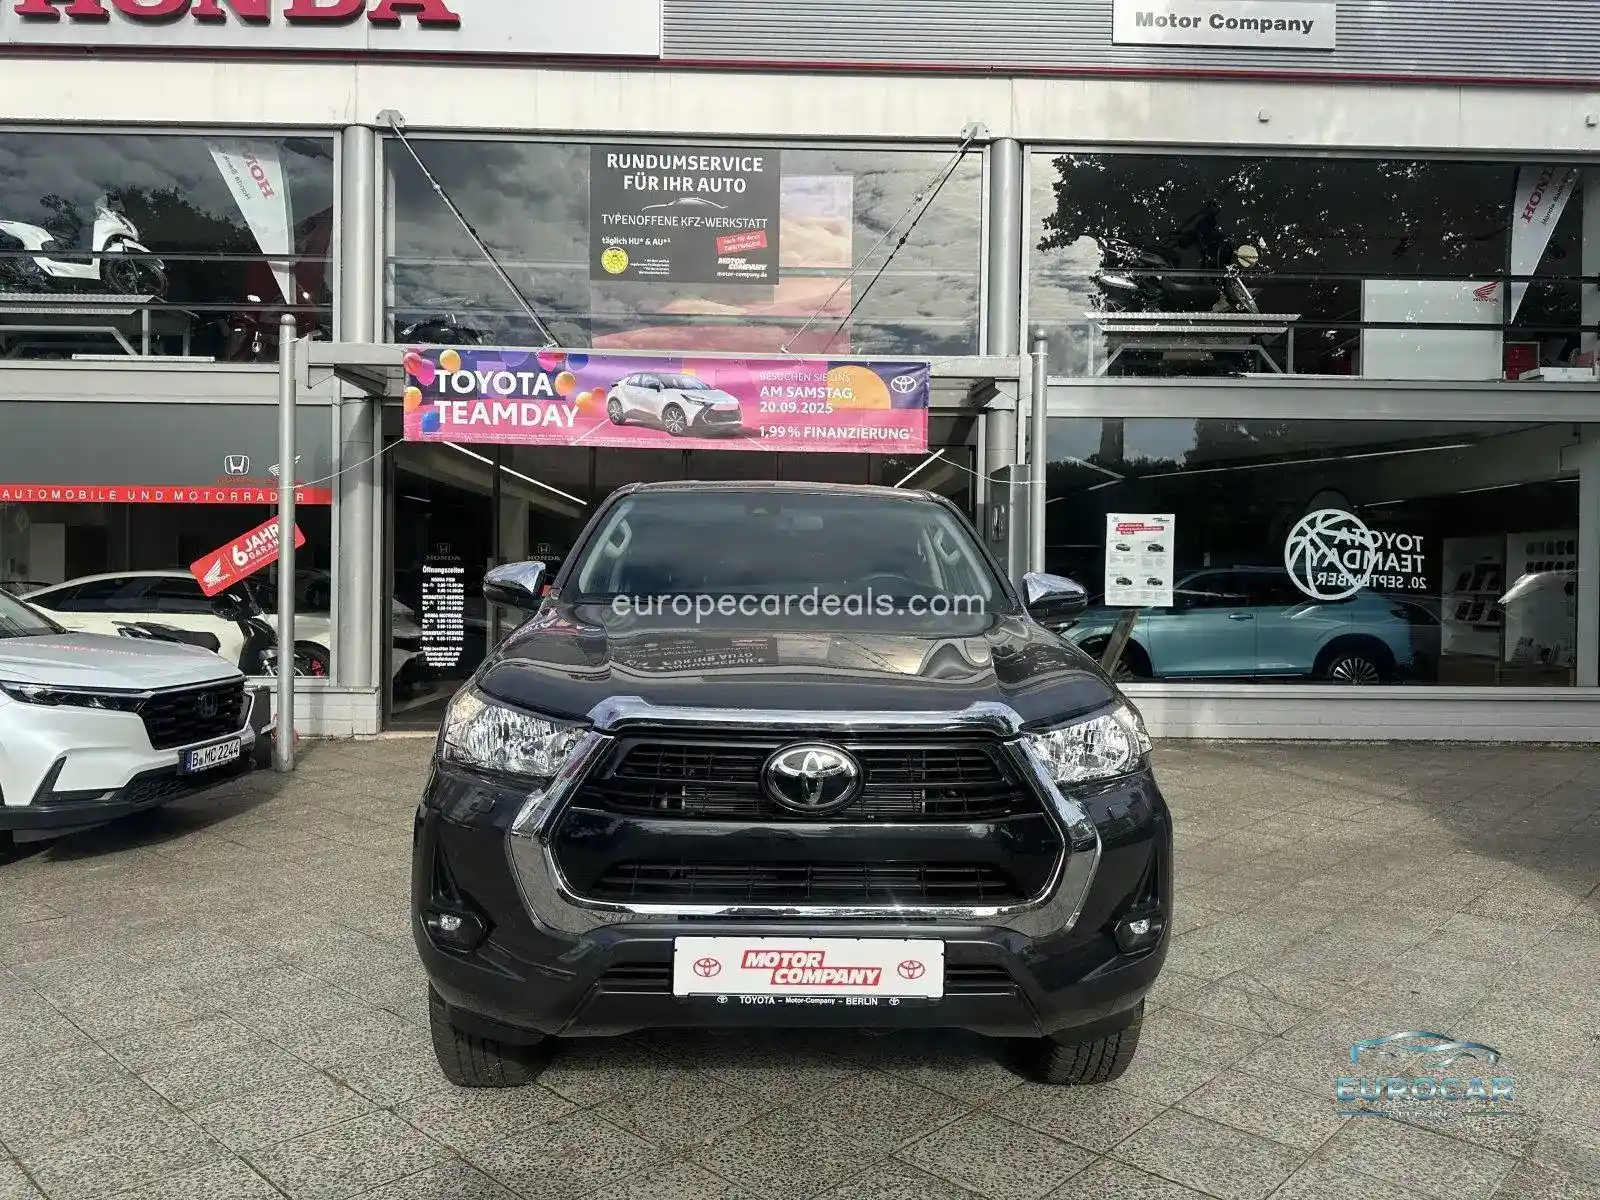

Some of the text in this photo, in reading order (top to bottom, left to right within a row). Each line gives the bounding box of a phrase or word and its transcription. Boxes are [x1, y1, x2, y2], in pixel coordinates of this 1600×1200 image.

[1135, 12, 1314, 34] Motor Company
[607, 153, 763, 172] RUNDUMSERVICE
[623, 172, 747, 193] FÜR IHR AUTO
[602, 213, 768, 229] TYPENOFFENE KFZ-WERKSTATT
[602, 237, 627, 246] täglich
[645, 238, 651, 246] &
[717, 257, 747, 265] MOTOR
[716, 270, 768, 279] motor-company.de
[433, 369, 554, 397] TOYOTA
[759, 371, 851, 383] BESUCHEN SIE UNS
[759, 386, 857, 402] AM SAMSTAG,
[434, 400, 579, 428] TEAMDAY
[759, 401, 834, 414] 20.09.2025
[759, 425, 786, 439] 1,99
[787, 426, 799, 438] %
[2, 489, 305, 502] AUTOMOBILE UND MOTORRÄDR
[232, 544, 249, 567] 6
[245, 522, 280, 553] JAHR
[248, 538, 279, 560] GARAN
[192, 752, 199, 767] B
[204, 749, 217, 763] MC
[217, 742, 239, 760] 2244
[745, 951, 823, 968] MOTOR
[772, 968, 881, 985] COMPANY
[739, 995, 775, 1005] TOYOTA
[785, 997, 836, 1006] Motor-Company
[845, 996, 878, 1006] BERLIN
